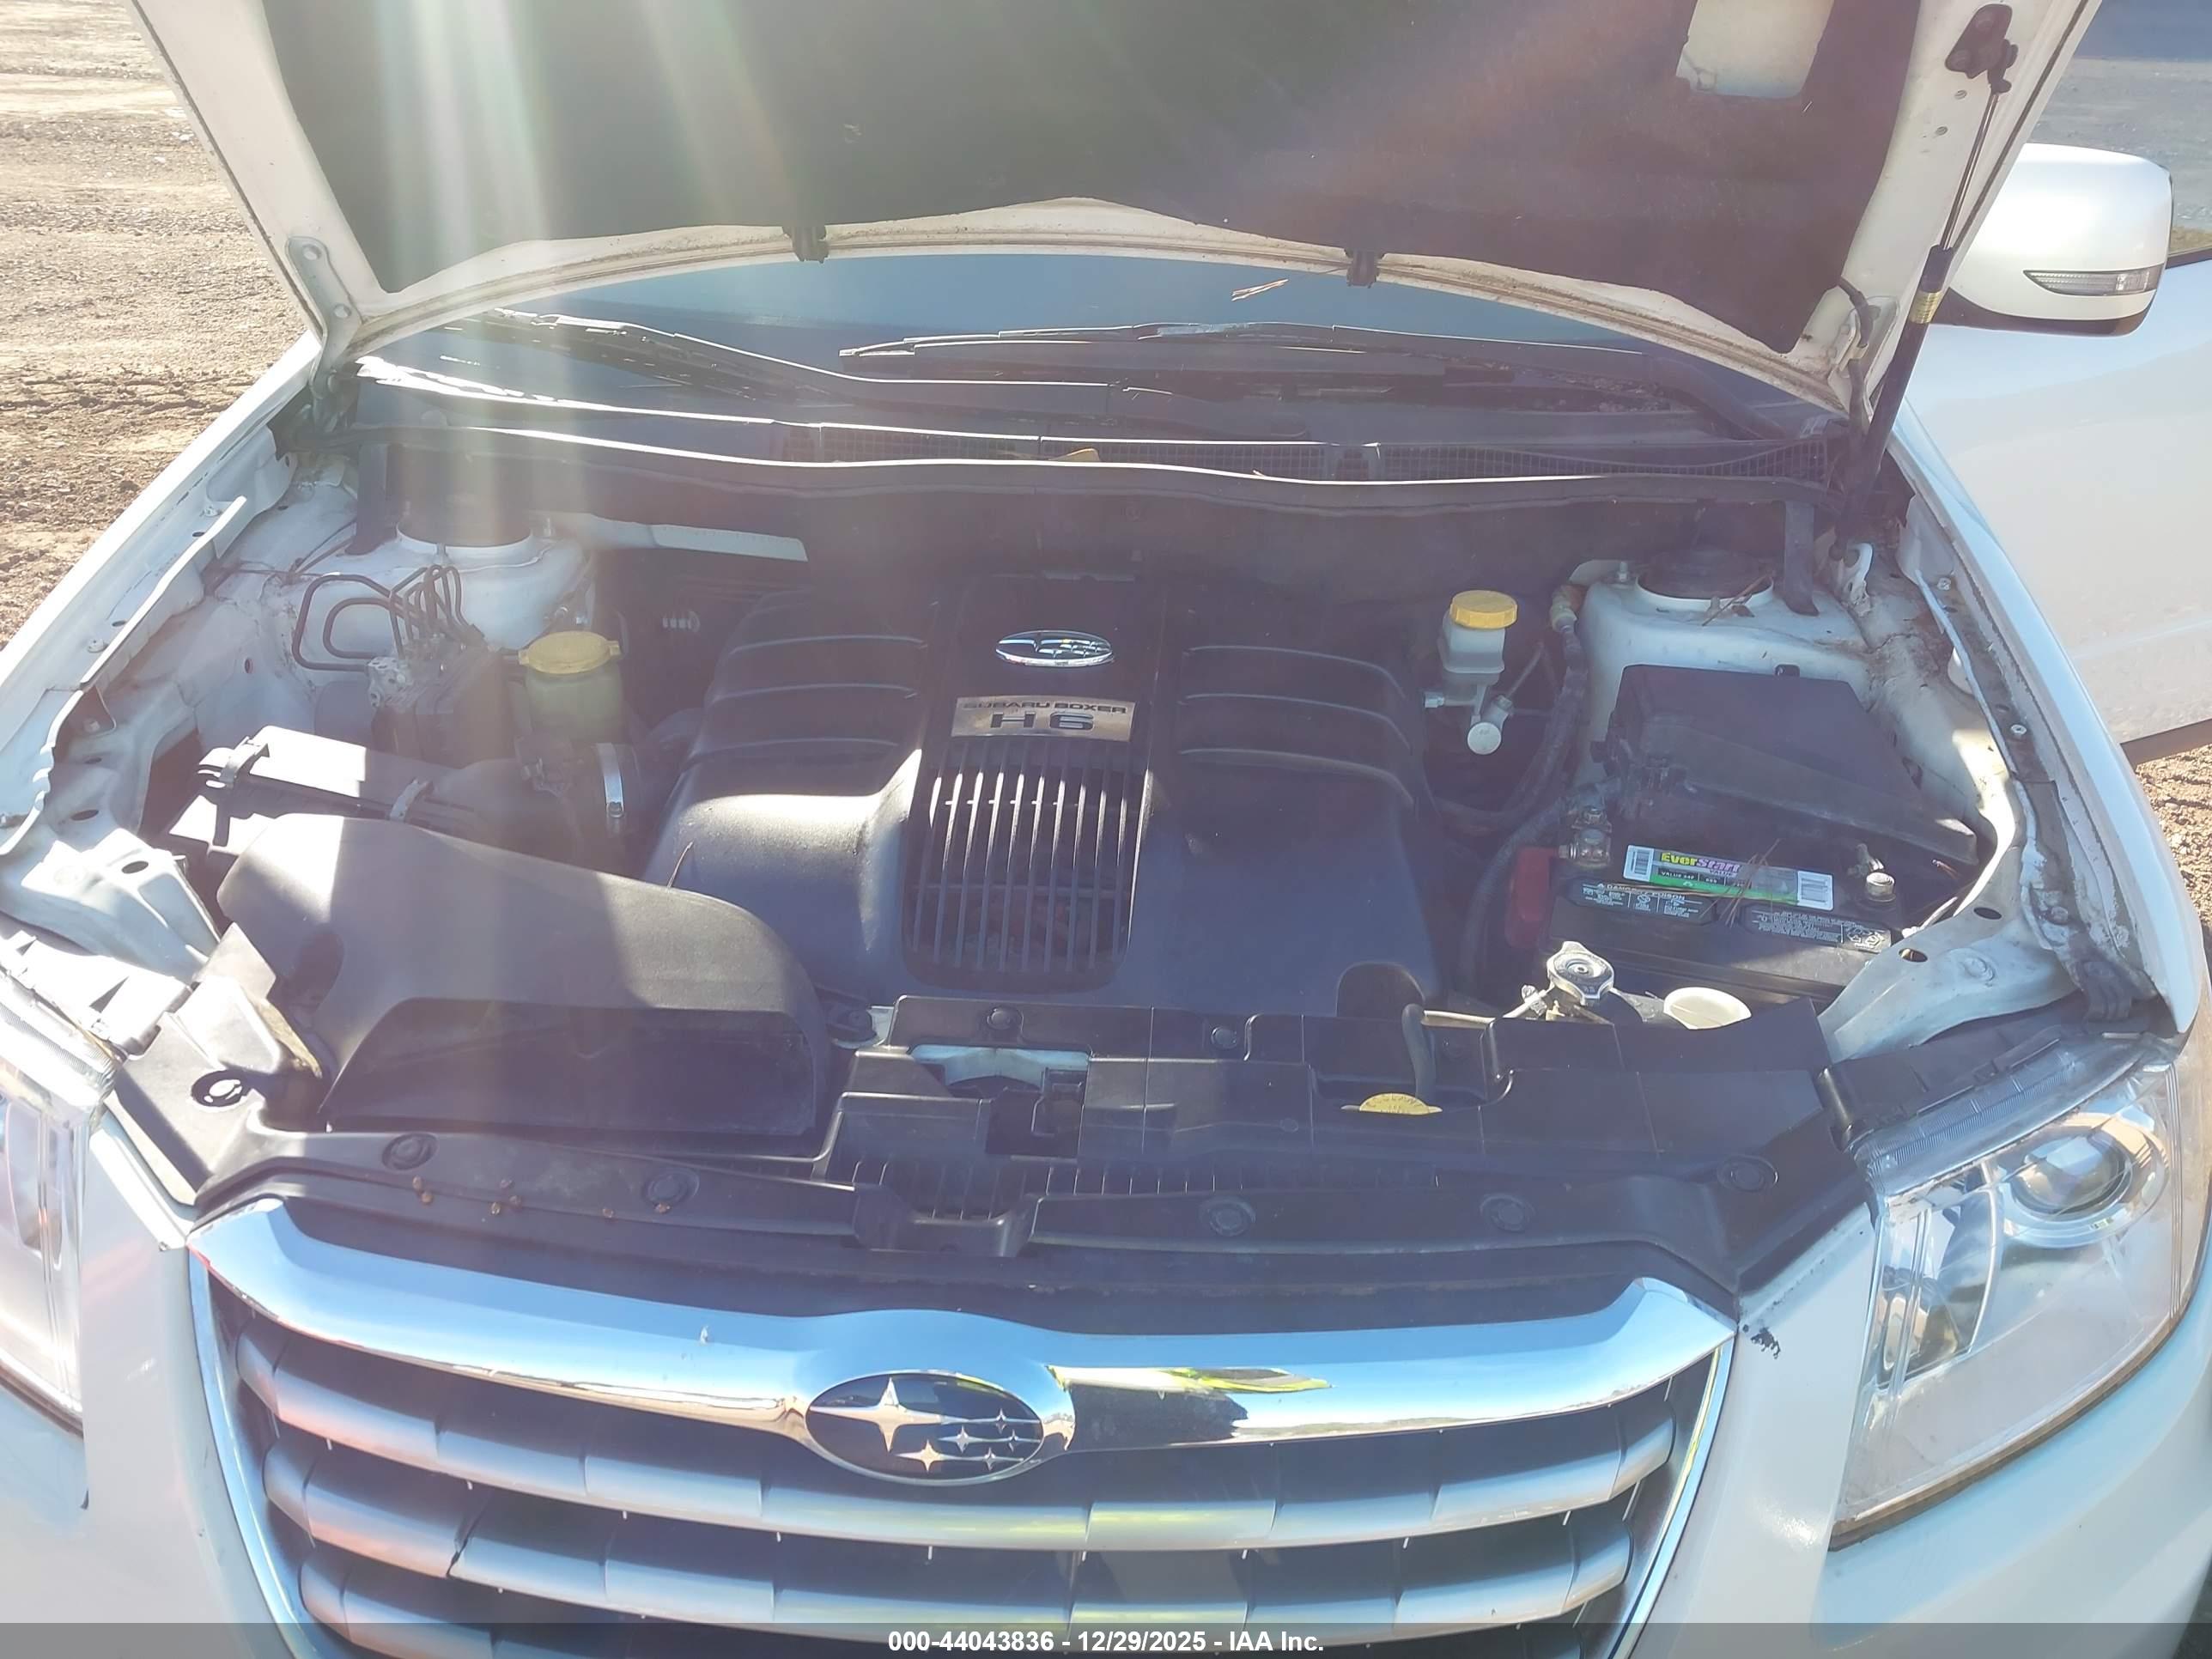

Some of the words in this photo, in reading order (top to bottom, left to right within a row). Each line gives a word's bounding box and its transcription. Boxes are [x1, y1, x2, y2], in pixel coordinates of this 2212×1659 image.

[963, 702, 1050, 711] SUBARU
[1054, 702, 1127, 714] BOXER
[990, 712, 1095, 731] H6
[1661, 852, 1742, 872] EverStart
